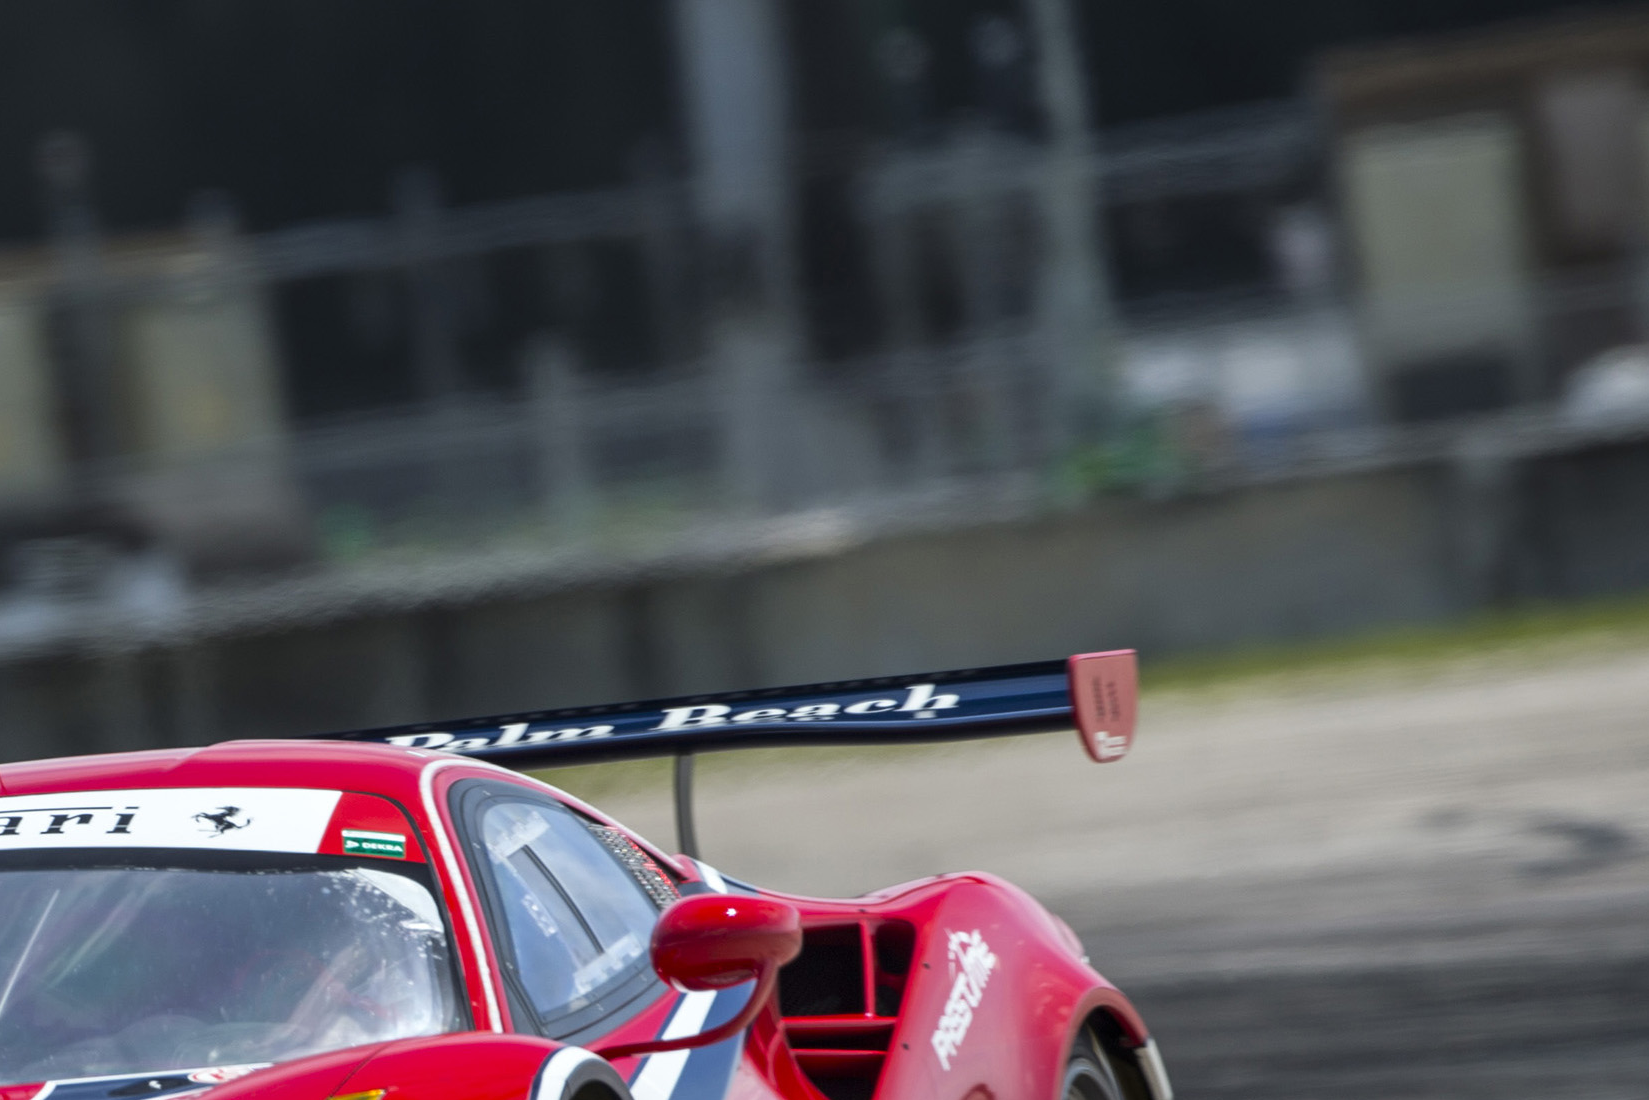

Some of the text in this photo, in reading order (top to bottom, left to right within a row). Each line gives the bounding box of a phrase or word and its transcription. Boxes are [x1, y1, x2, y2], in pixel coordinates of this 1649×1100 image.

[385, 683, 960, 752] Palm Beach
[362, 842, 403, 852] DEKRA
